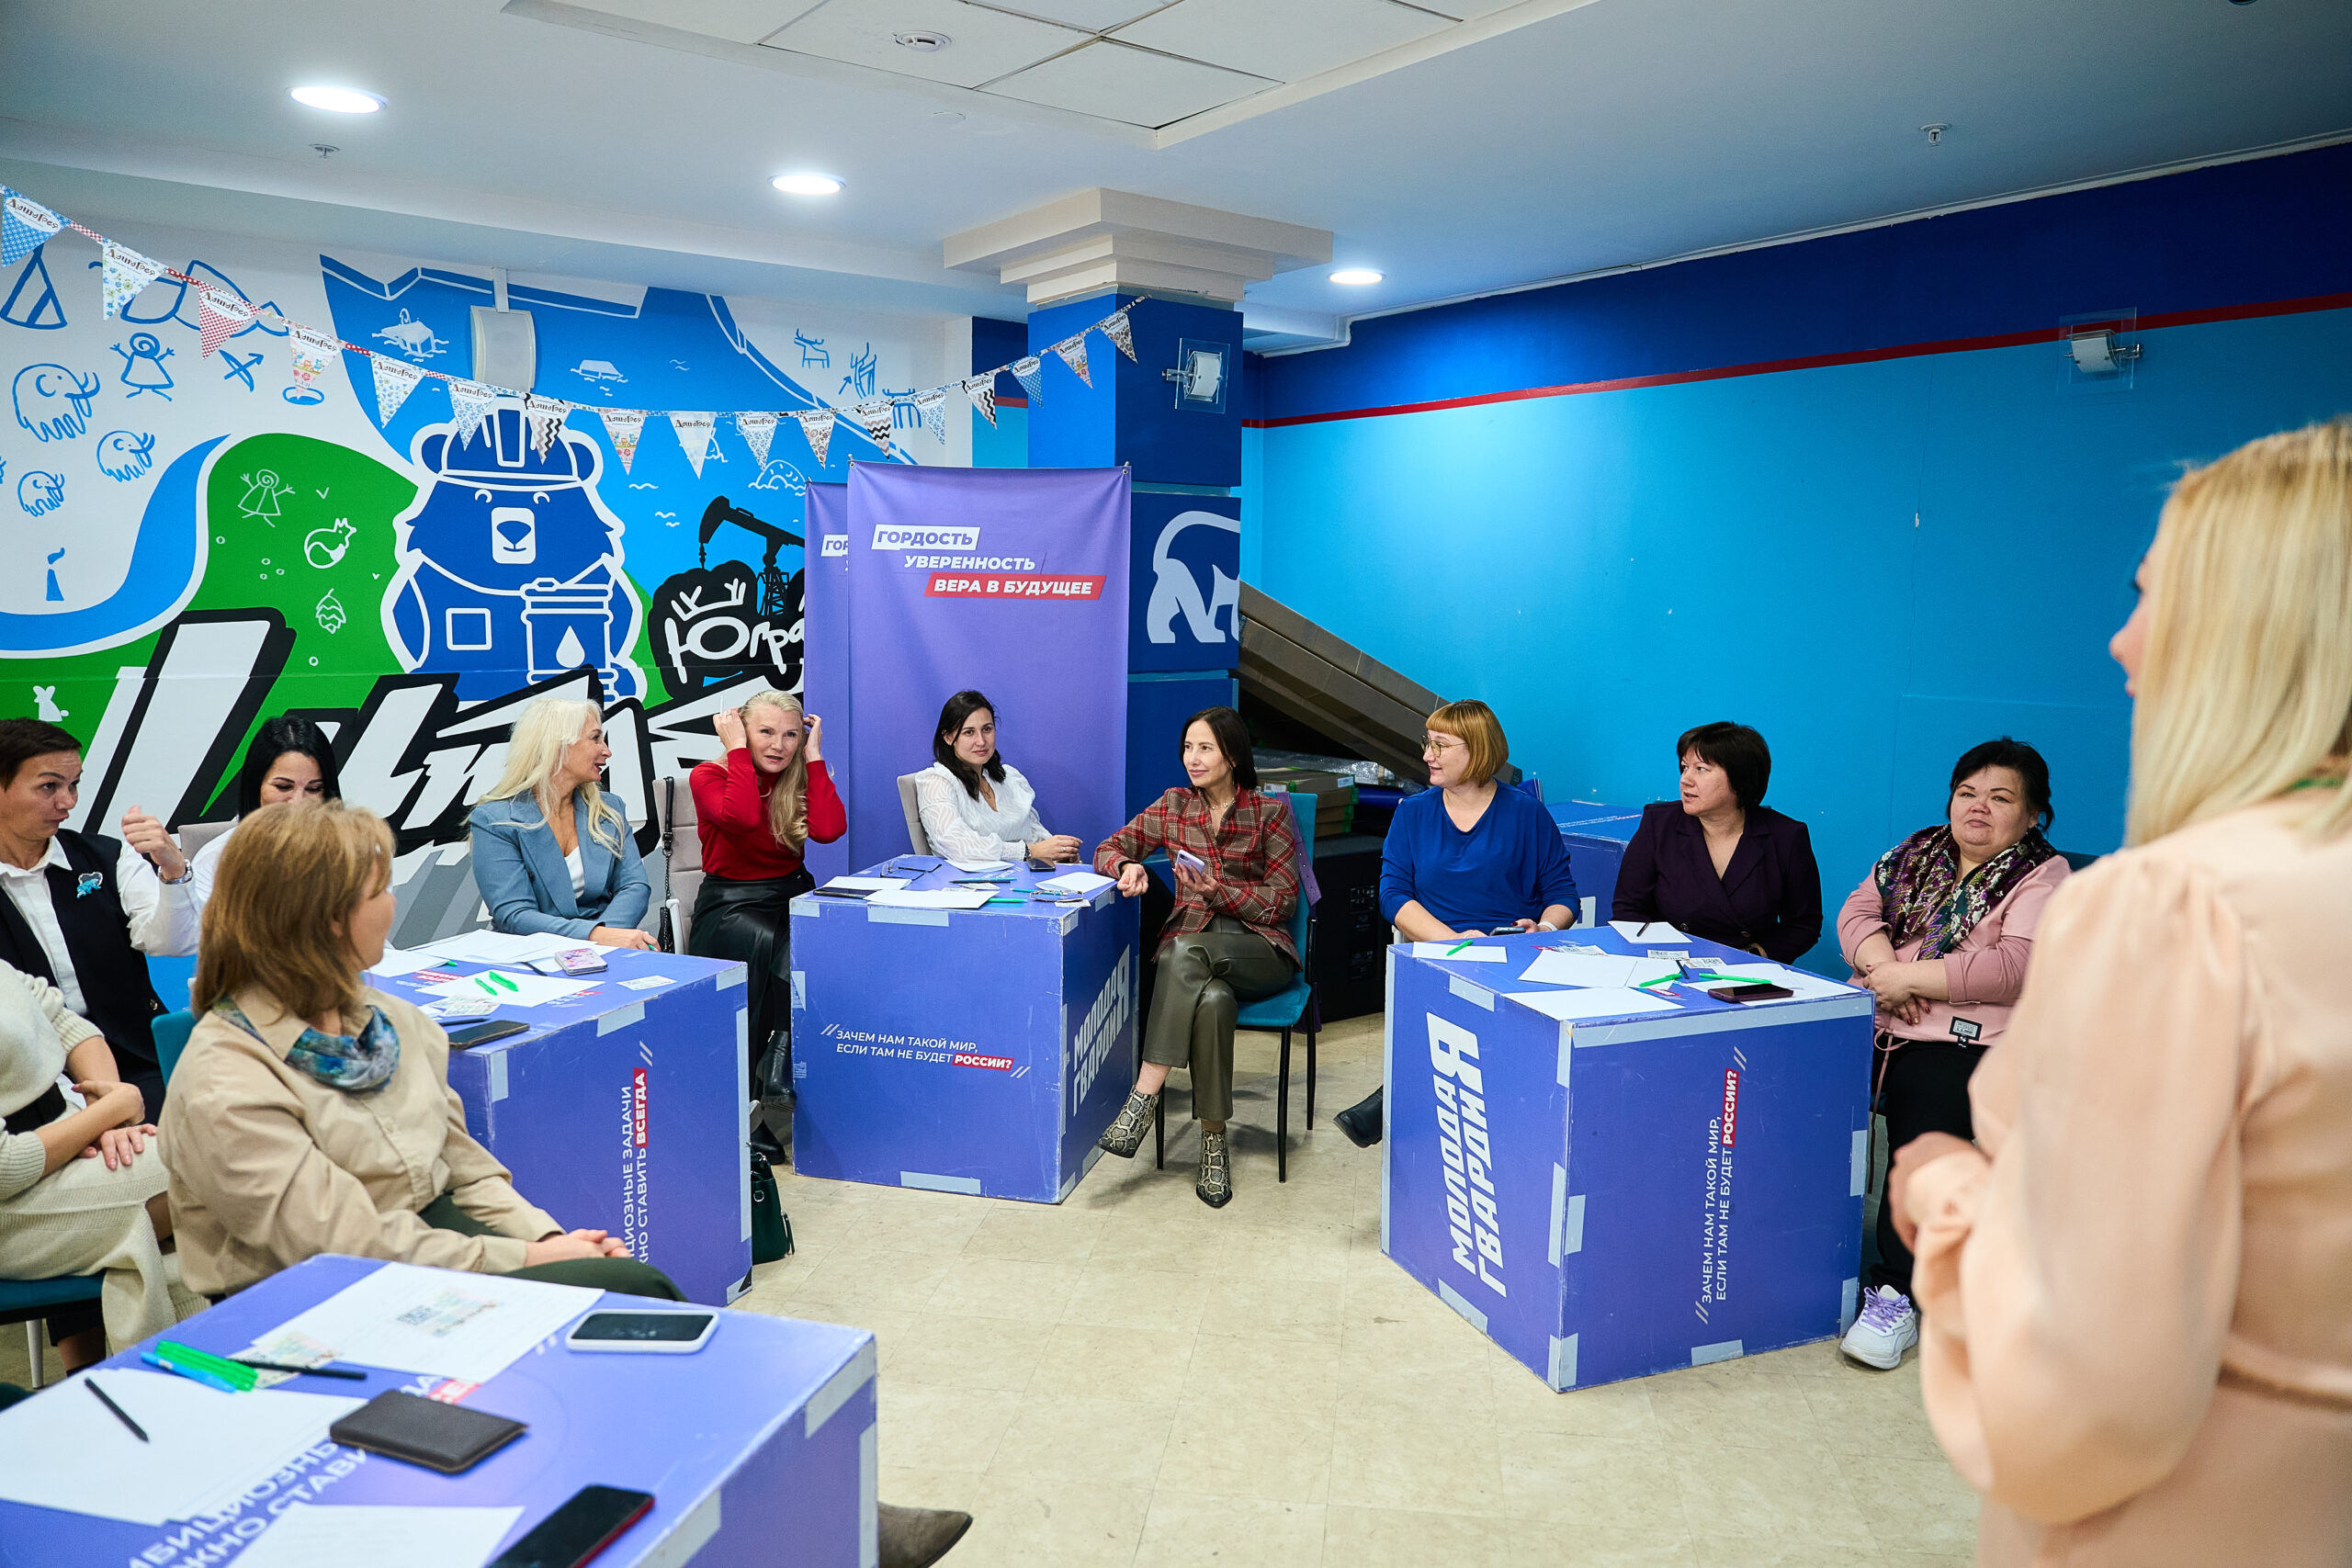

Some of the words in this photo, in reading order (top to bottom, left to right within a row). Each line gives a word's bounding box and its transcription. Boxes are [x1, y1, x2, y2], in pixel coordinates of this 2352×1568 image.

[876, 530, 973, 546] ГОРДОСТЬ
[904, 555, 1036, 570] УВЕРЕННОСТЬ
[933, 579, 981, 593] ВЕРА
[987, 581, 1000, 593] В
[1003, 581, 1093, 596] БУДУЩЕЕ
[836, 1031, 875, 1043] ЗАЧЕМ
[877, 1034, 904, 1045] НАМ
[908, 1036, 946, 1049] ТАКОЙ
[950, 1041, 978, 1054] МИР,
[836, 1043, 867, 1055] ЕСЛИ
[870, 1046, 895, 1057] ТАМ
[897, 1049, 912, 1059] НЕ
[915, 1051, 953, 1064] БУДЕТ
[954, 1055, 1012, 1069] РОССИИ?
[621, 1086, 634, 1159] ЗАДАЧИ
[635, 1073, 647, 1145] ВСЕГДА
[1722, 1070, 1738, 1145] РОССИИ?
[1709, 1116, 1722, 1156] МИР,
[637, 1148, 649, 1226] СТАВИТЬ
[1705, 1157, 1718, 1210] ТАКОЙ
[1720, 1146, 1734, 1196] БУДЕТ
[1719, 1200, 1729, 1220] НЕ
[1703, 1213, 1714, 1249] НАМ
[1717, 1226, 1727, 1258] ТАМ
[1702, 1252, 1713, 1304] ЗАЧЕМ
[1716, 1261, 1727, 1301] ЕСЛИ
